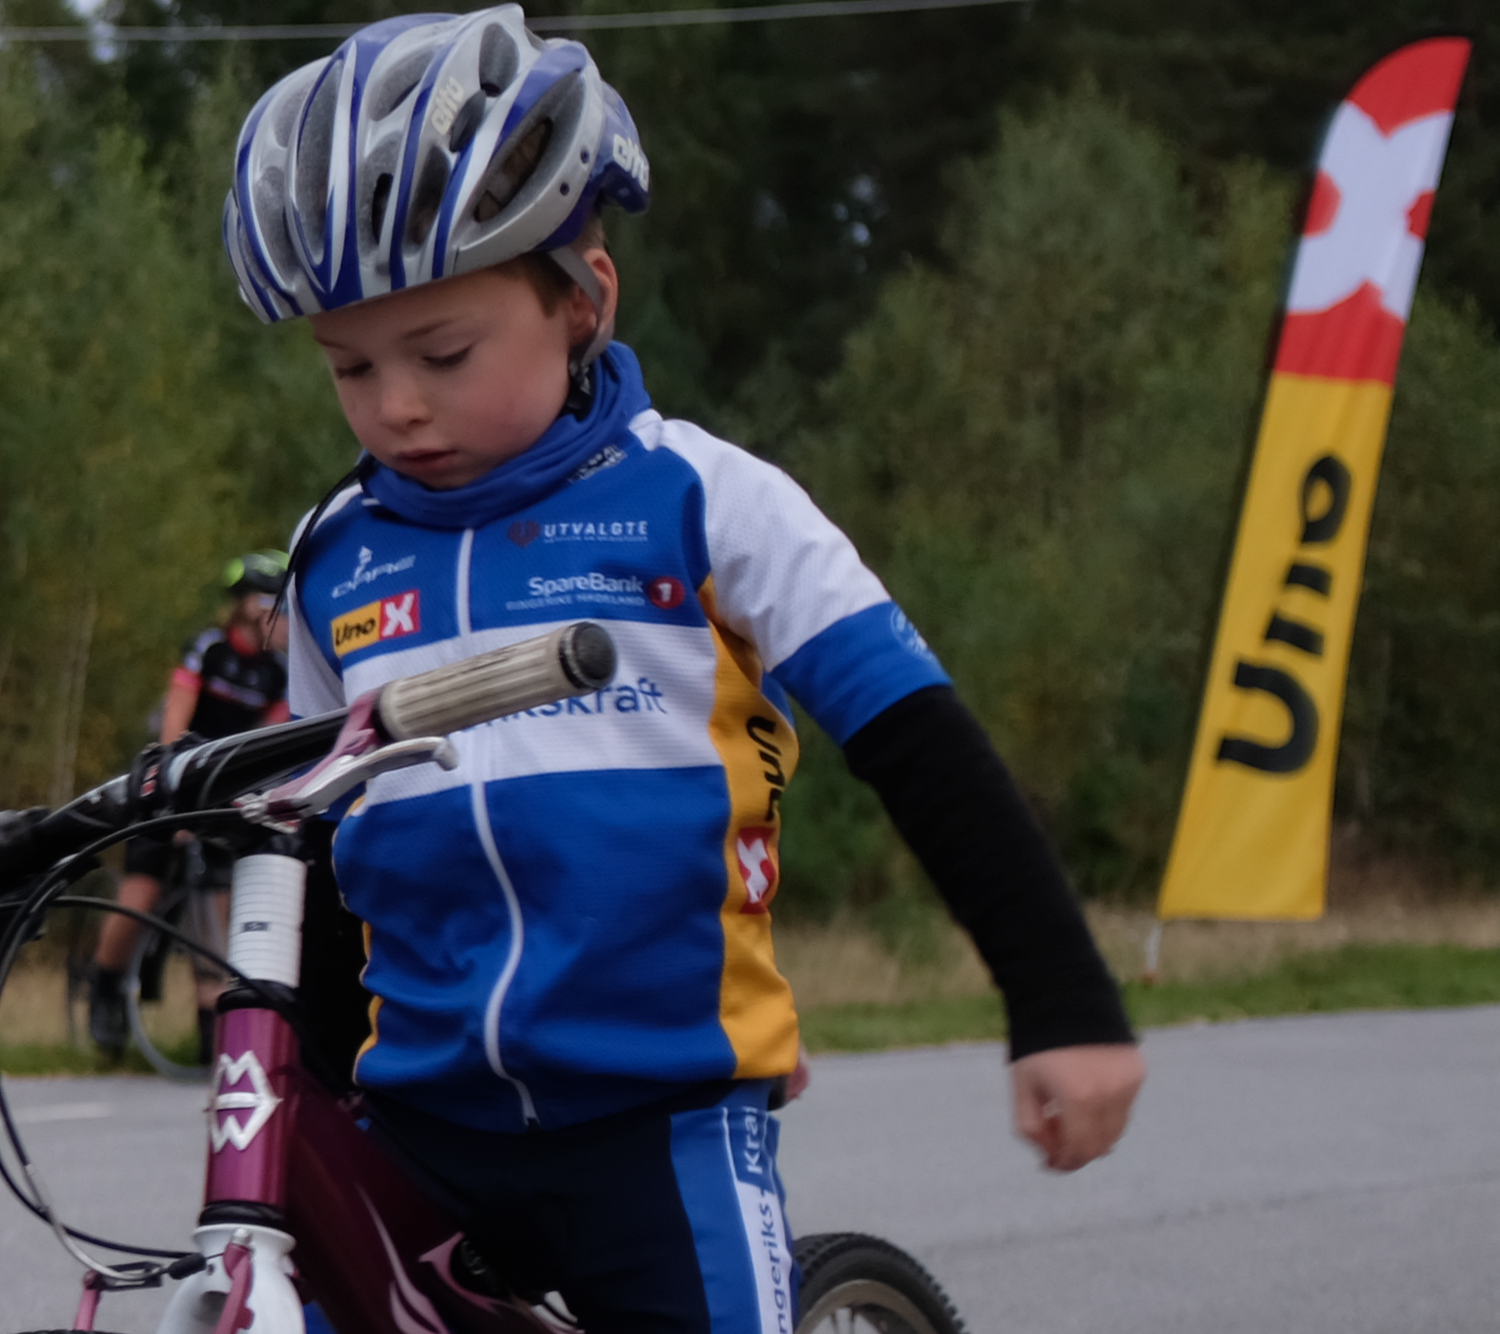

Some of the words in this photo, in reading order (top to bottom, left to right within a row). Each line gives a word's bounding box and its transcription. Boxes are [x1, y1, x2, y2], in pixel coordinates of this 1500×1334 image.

[527, 572, 644, 597] SpareBank
[335, 616, 376, 647] Uno
[1215, 455, 1352, 777] Uno
